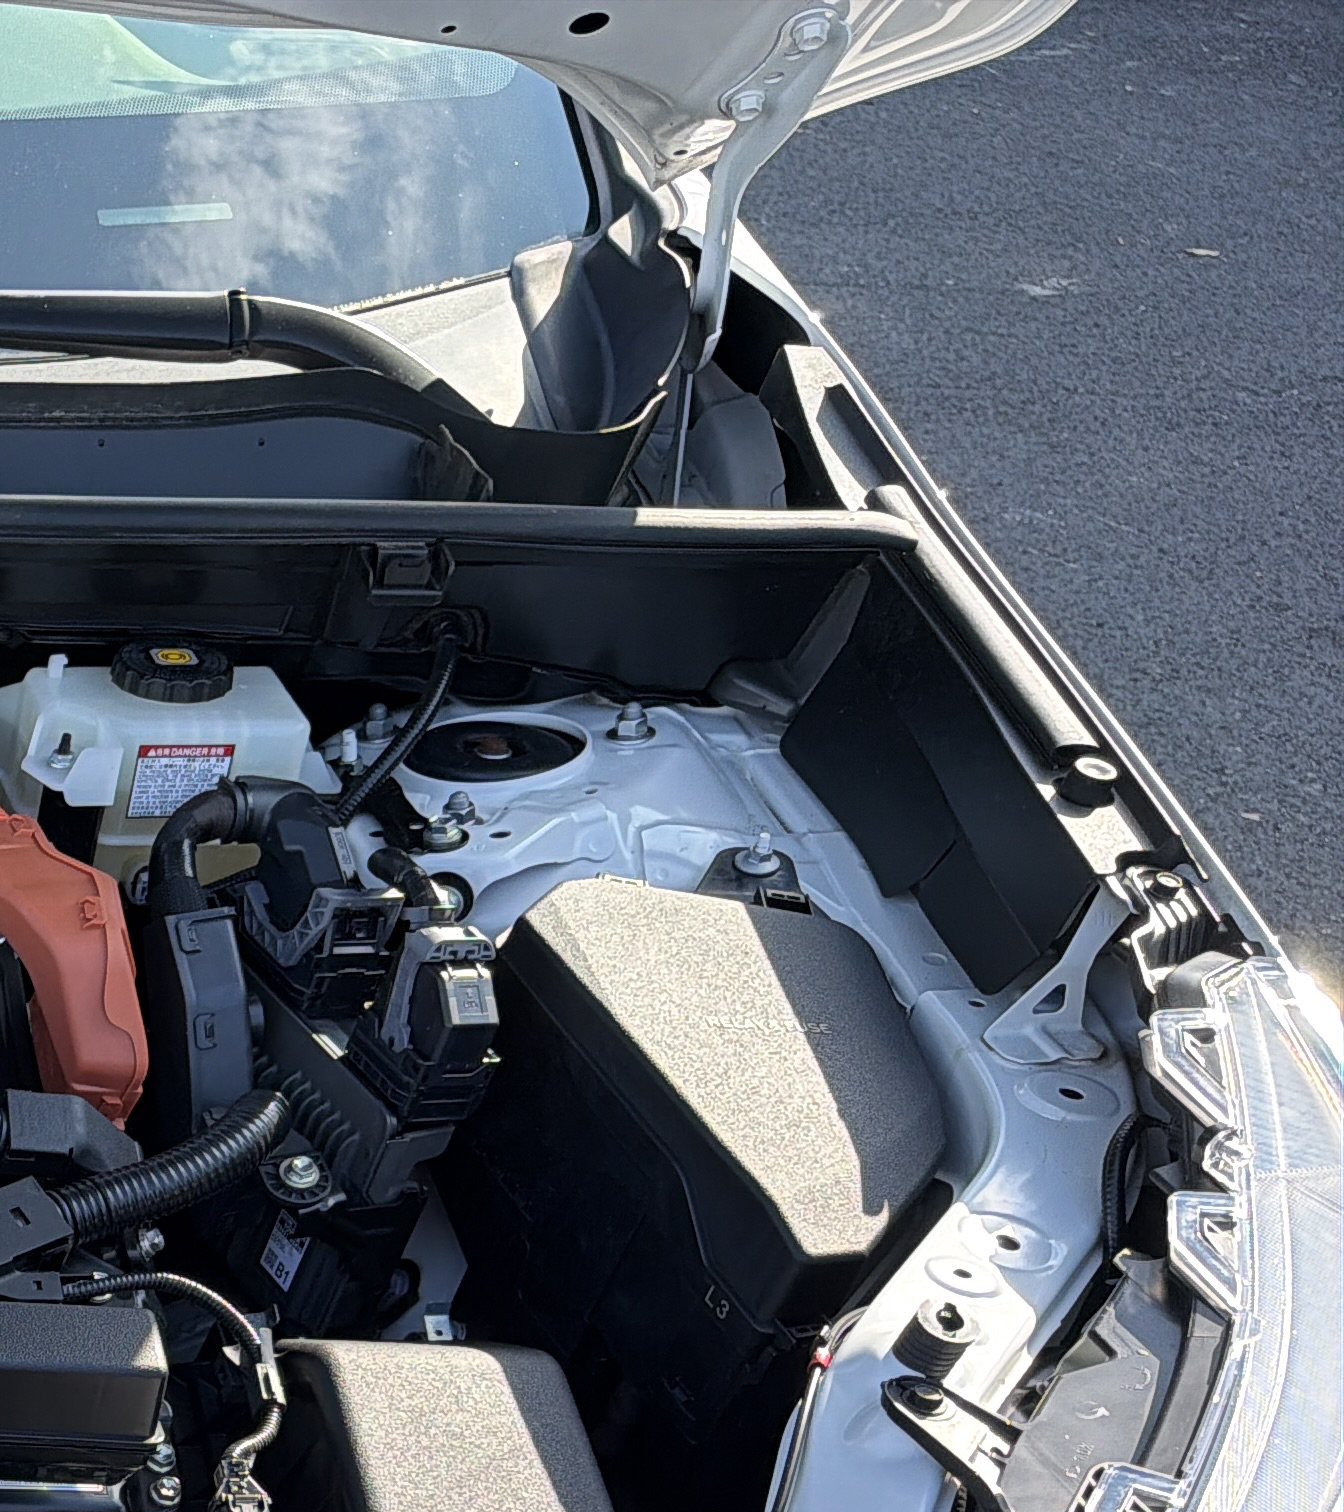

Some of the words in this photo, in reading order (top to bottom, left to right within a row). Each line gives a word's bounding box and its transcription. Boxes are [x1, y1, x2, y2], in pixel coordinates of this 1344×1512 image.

[171, 747, 209, 756] DANGER
[704, 1015, 770, 1035] RELAY
[783, 1020, 833, 1034] FUSE
[274, 1261, 291, 1286] B1
[704, 1284, 730, 1320] L3
